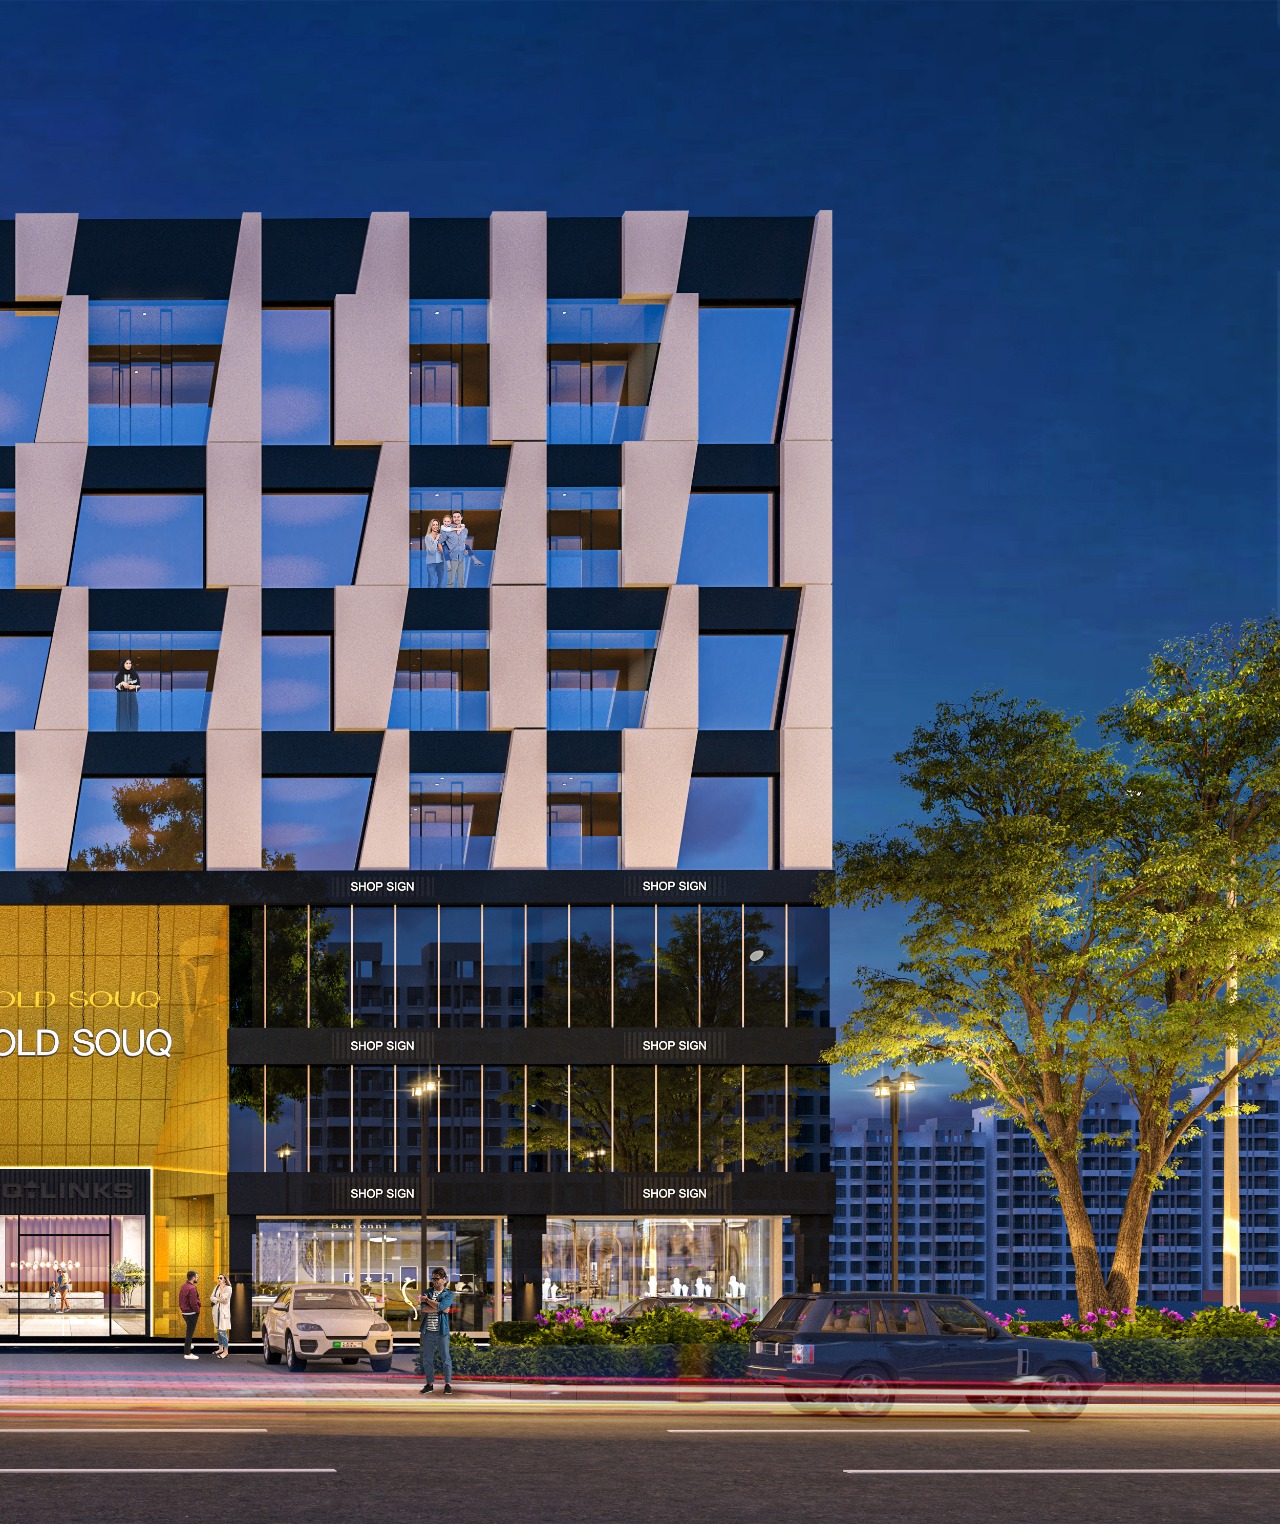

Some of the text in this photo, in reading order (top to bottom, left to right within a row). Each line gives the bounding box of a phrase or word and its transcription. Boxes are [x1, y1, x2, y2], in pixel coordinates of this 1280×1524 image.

[350, 881, 415, 892] SHOP SIGN
[642, 881, 707, 892] SHOP SIGN
[69, 991, 160, 1008] SOUQ
[72, 1028, 172, 1058] SOUQ
[350, 1040, 415, 1051] SHOP SIGN
[642, 1040, 707, 1051] SHOP SIGN
[350, 1188, 415, 1199] SHOP SIGN
[642, 1188, 707, 1199] SHOP SIGN
